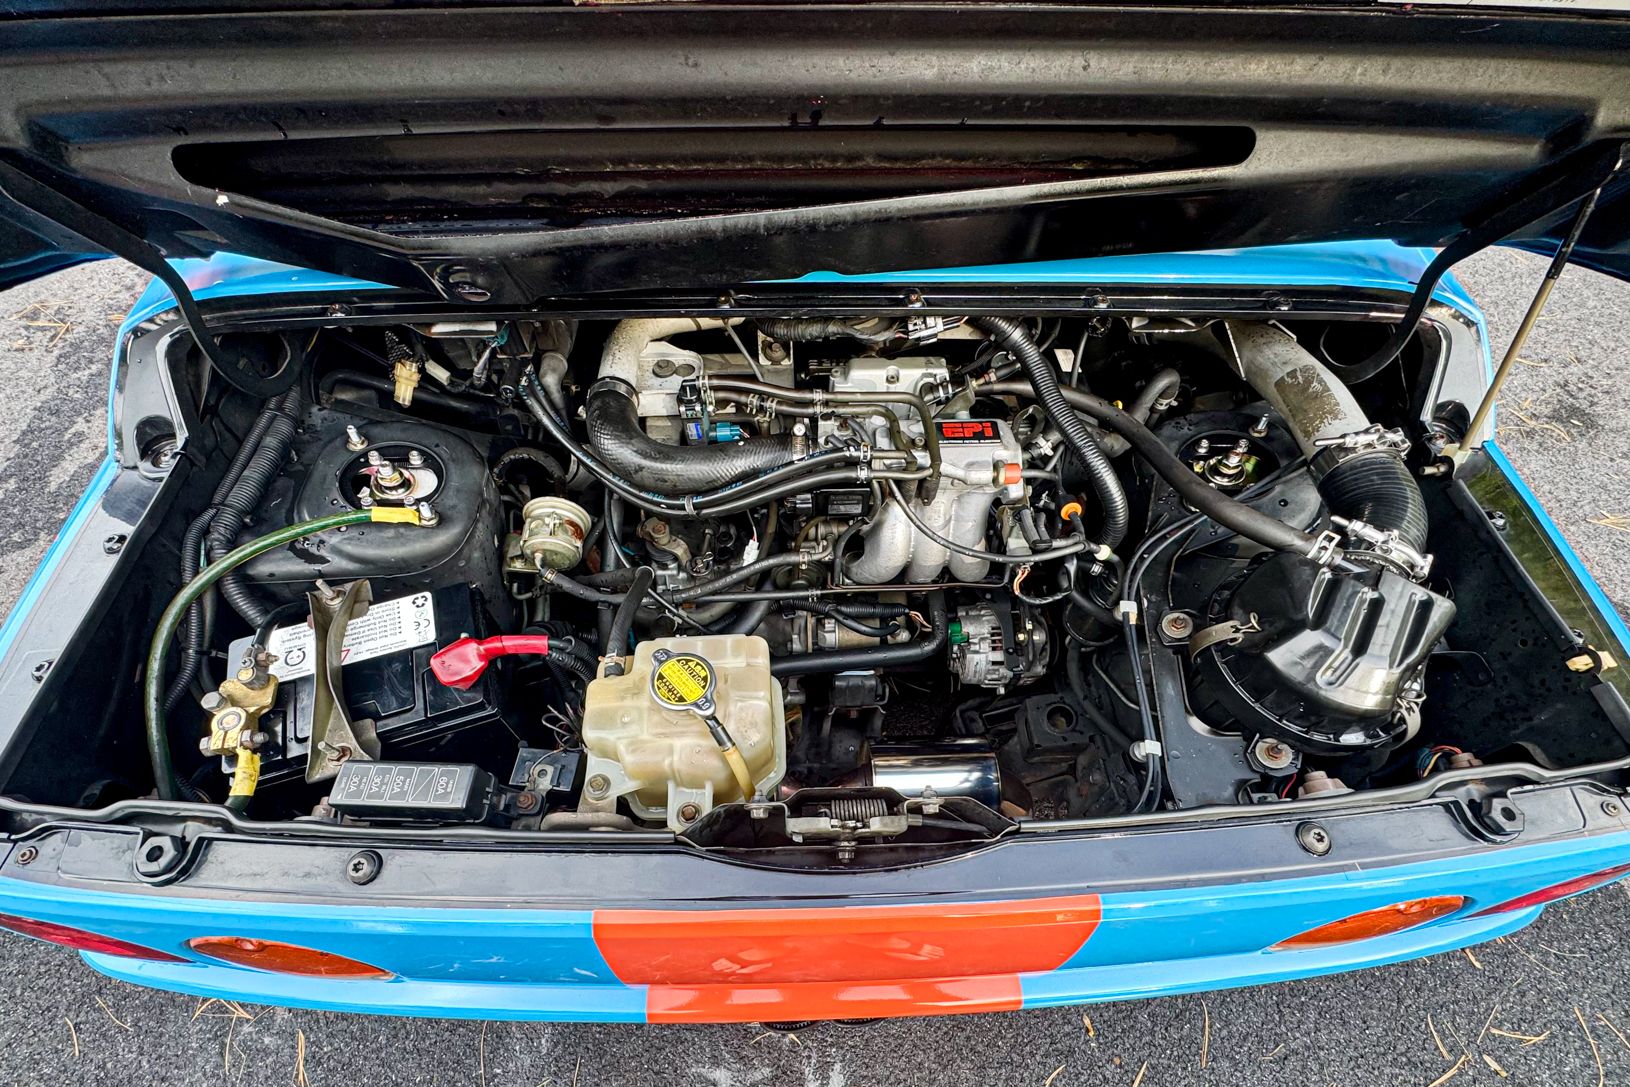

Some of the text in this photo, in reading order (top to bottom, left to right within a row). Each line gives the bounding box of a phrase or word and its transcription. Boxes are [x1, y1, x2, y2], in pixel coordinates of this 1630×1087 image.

[942, 422, 993, 438] EPi
[679, 660, 705, 686] CAUTION
[657, 680, 678, 700] COOLANT
[663, 679, 681, 697] ENGINE
[350, 774, 360, 791] 30A
[371, 775, 382, 792] 30A
[393, 775, 403, 792] 50A
[437, 776, 447, 793] 60A
